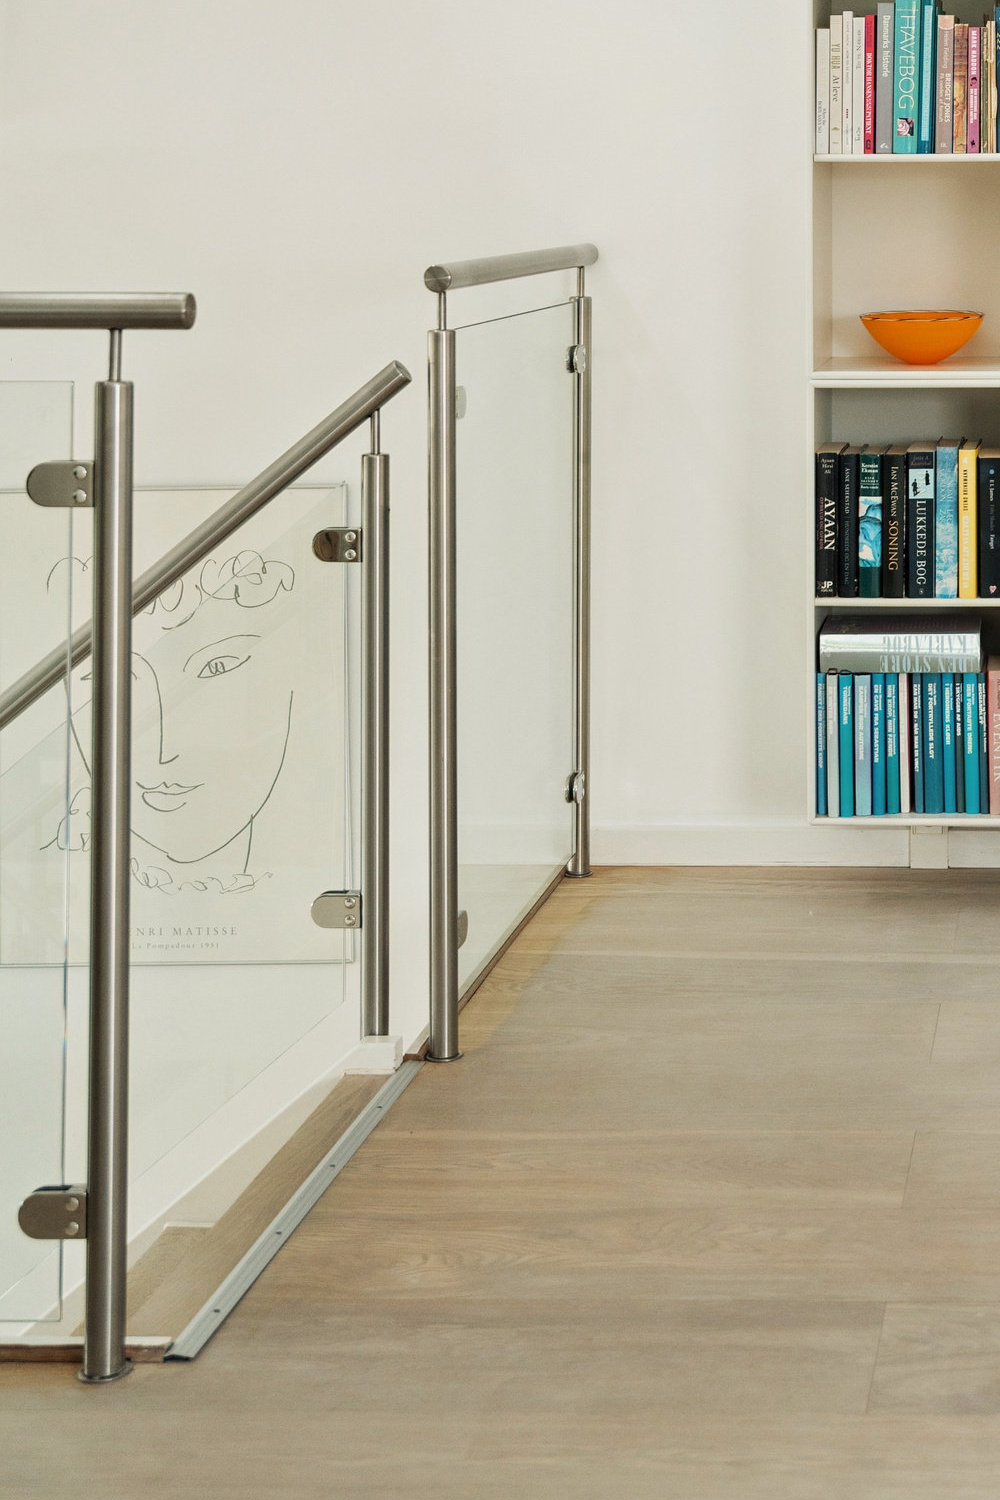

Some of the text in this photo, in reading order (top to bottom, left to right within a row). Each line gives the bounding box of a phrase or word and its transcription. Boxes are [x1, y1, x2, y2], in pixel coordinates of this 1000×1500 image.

[882, 15, 890, 77] Danmarks historie
[898, 15, 915, 109] HAVEBOG
[824, 497, 835, 550] AYAAN
[888, 520, 899, 571] SONING
[916, 500, 926, 585] LUKKEDE BOG
[873, 684, 879, 693] EN
[172, 927, 238, 935] MATISSE
